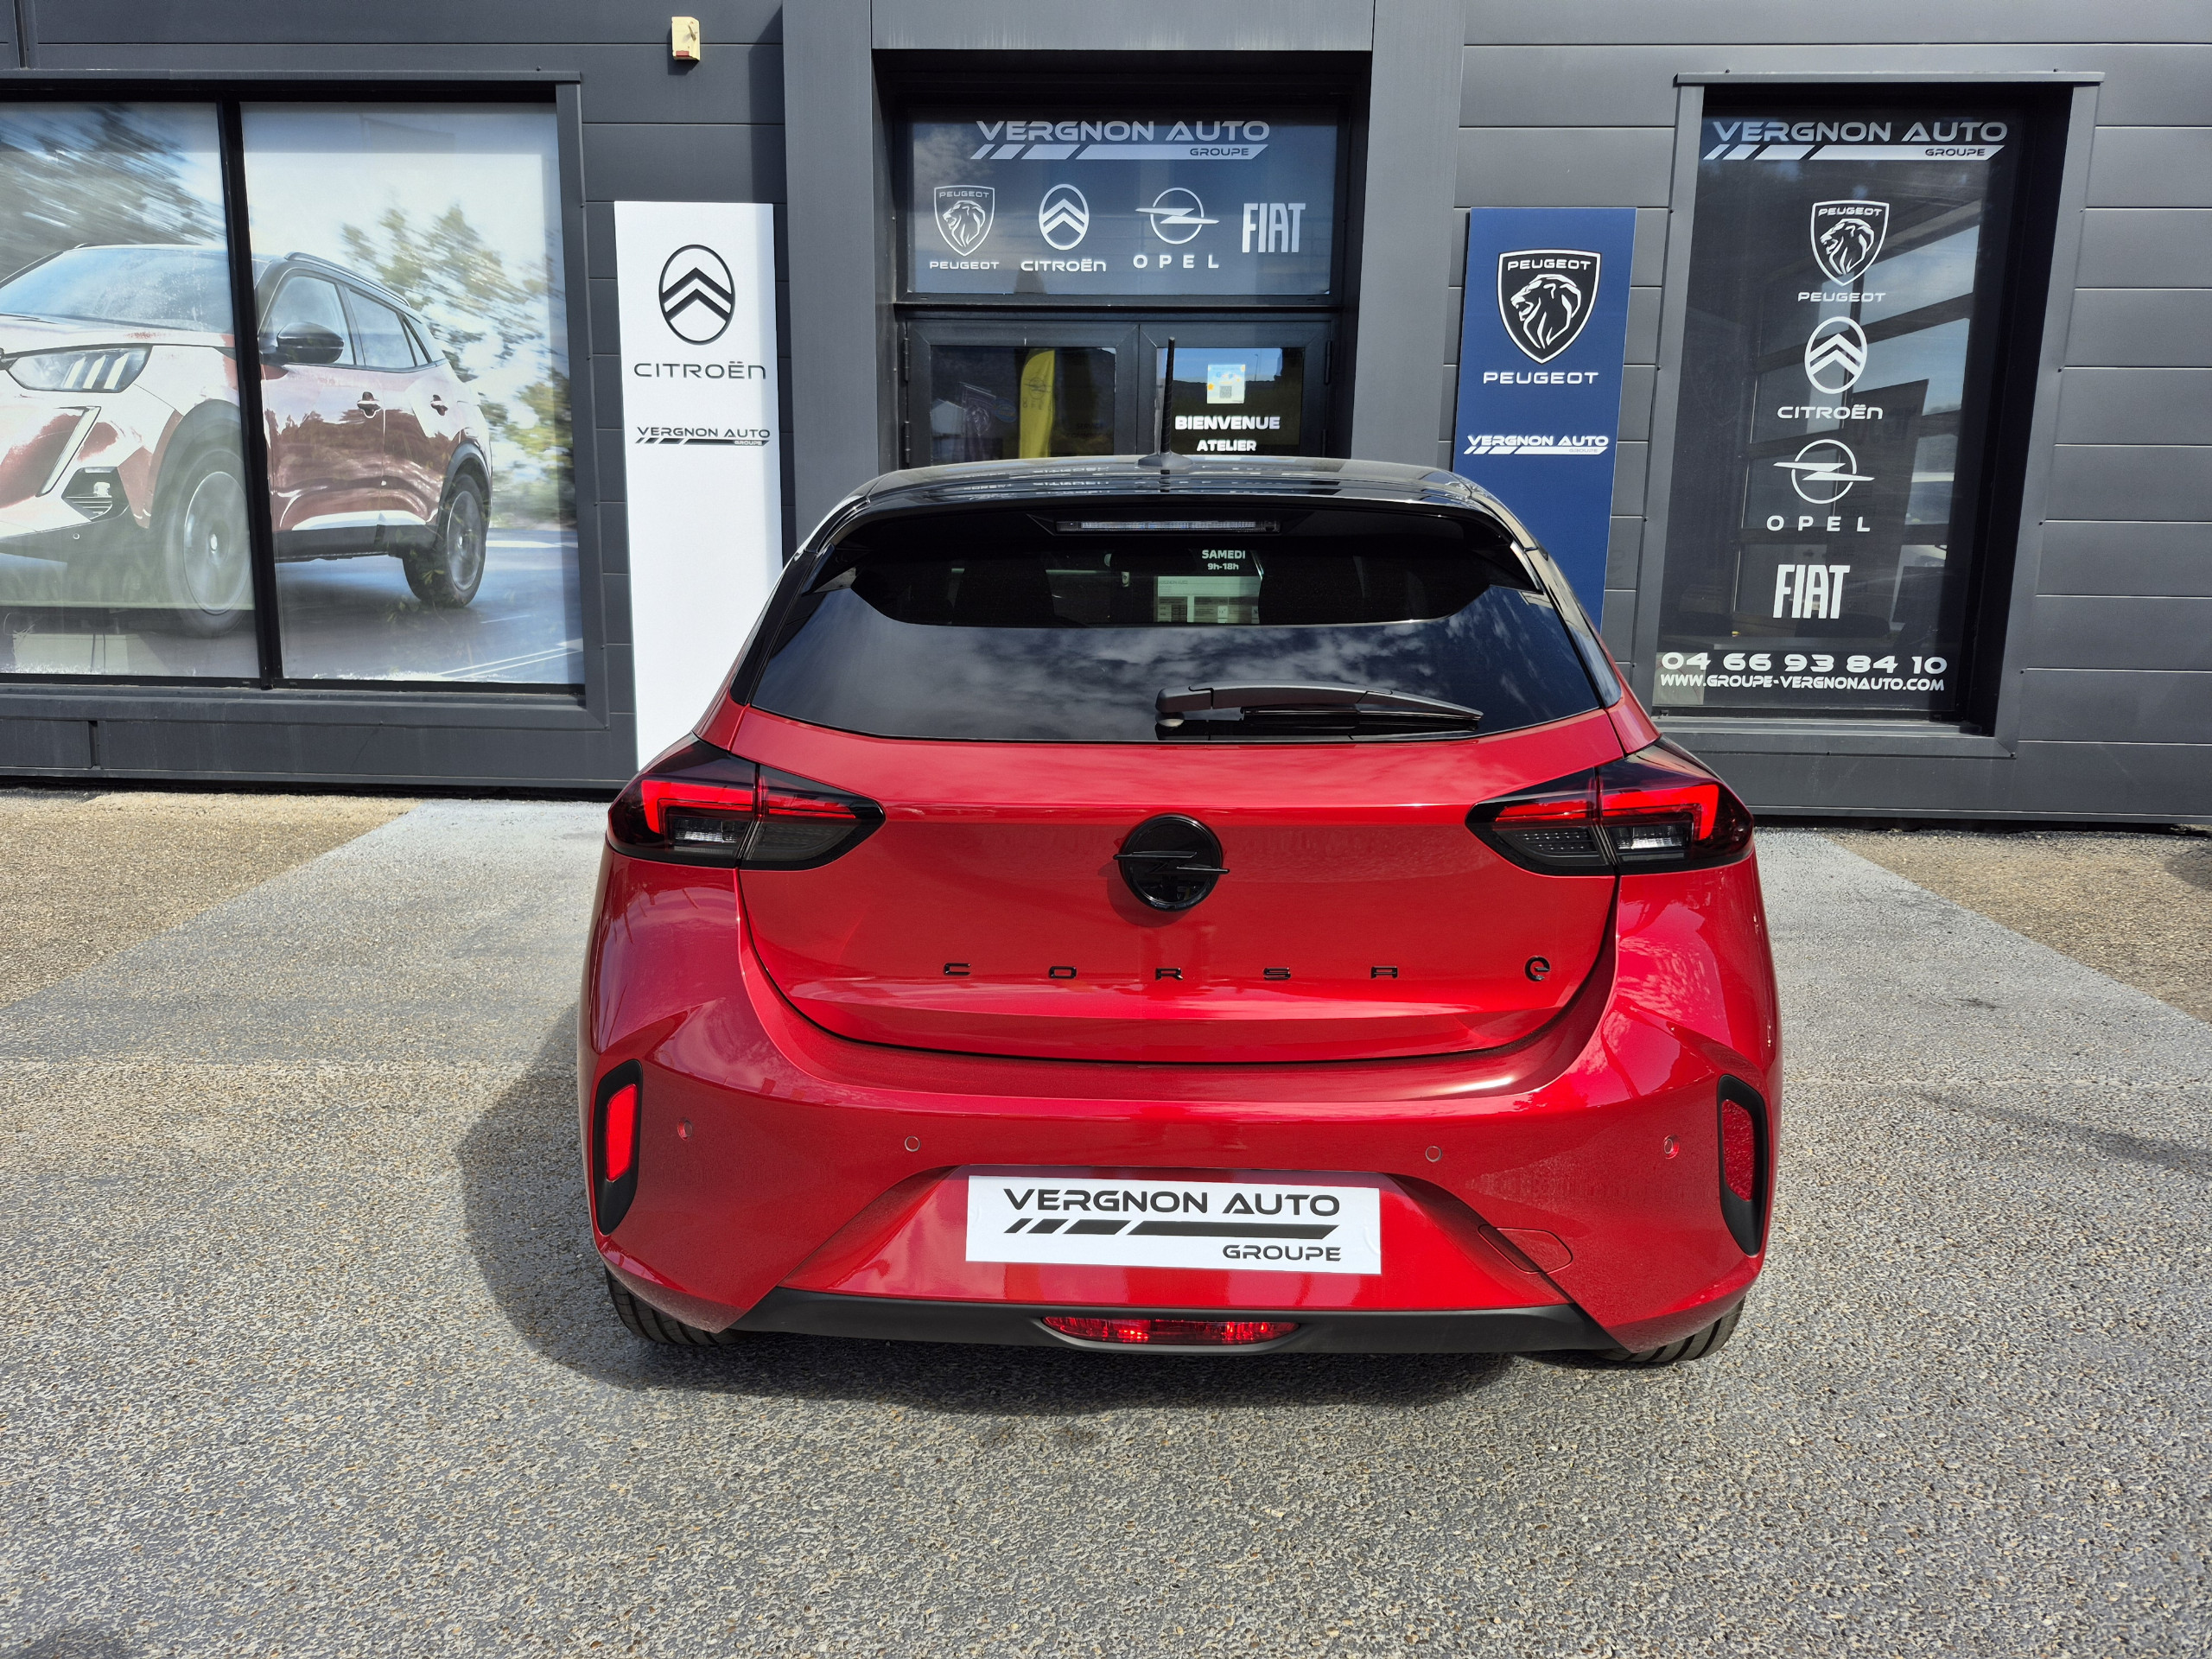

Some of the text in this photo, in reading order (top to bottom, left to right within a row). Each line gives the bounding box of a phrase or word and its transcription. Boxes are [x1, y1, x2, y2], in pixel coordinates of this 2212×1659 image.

[976, 120, 1270, 142] VERGNON AUTO
[1713, 121, 2008, 143] VERGNON AUTO
[1189, 148, 1249, 156] GROUPE
[1925, 148, 1986, 157] GROUPE
[938, 190, 989, 199] PEUGEOT
[1818, 207, 1883, 217] PEUGEOT
[1242, 202, 1306, 253] FIAT
[929, 260, 1000, 270] PEUGEOT
[1133, 254, 1220, 269] OPEL
[1507, 259, 1592, 271] PEUGEOT
[1797, 291, 1886, 302] PEUGEOT
[1483, 372, 1599, 385] PEUGEOT
[1175, 416, 1281, 430] BIENVENUE
[637, 426, 771, 439] VERGNON AUTO
[1196, 439, 1257, 452] ATELIER
[1467, 435, 1609, 447] VERGNON AUTO
[1766, 515, 1871, 532] OPEL
[1201, 550, 1246, 559] SAMEDI
[1772, 563, 1851, 620] FIAT
[1661, 652, 1948, 674] 04 66 93 84 10
[1660, 674, 1945, 691] WWW.GROUPE-VERGNONAUTO.COM
[943, 962, 1398, 982] CORSA
[1003, 1188, 1340, 1217] VERGNON AUTO
[1223, 1244, 1341, 1262] GROUPE
